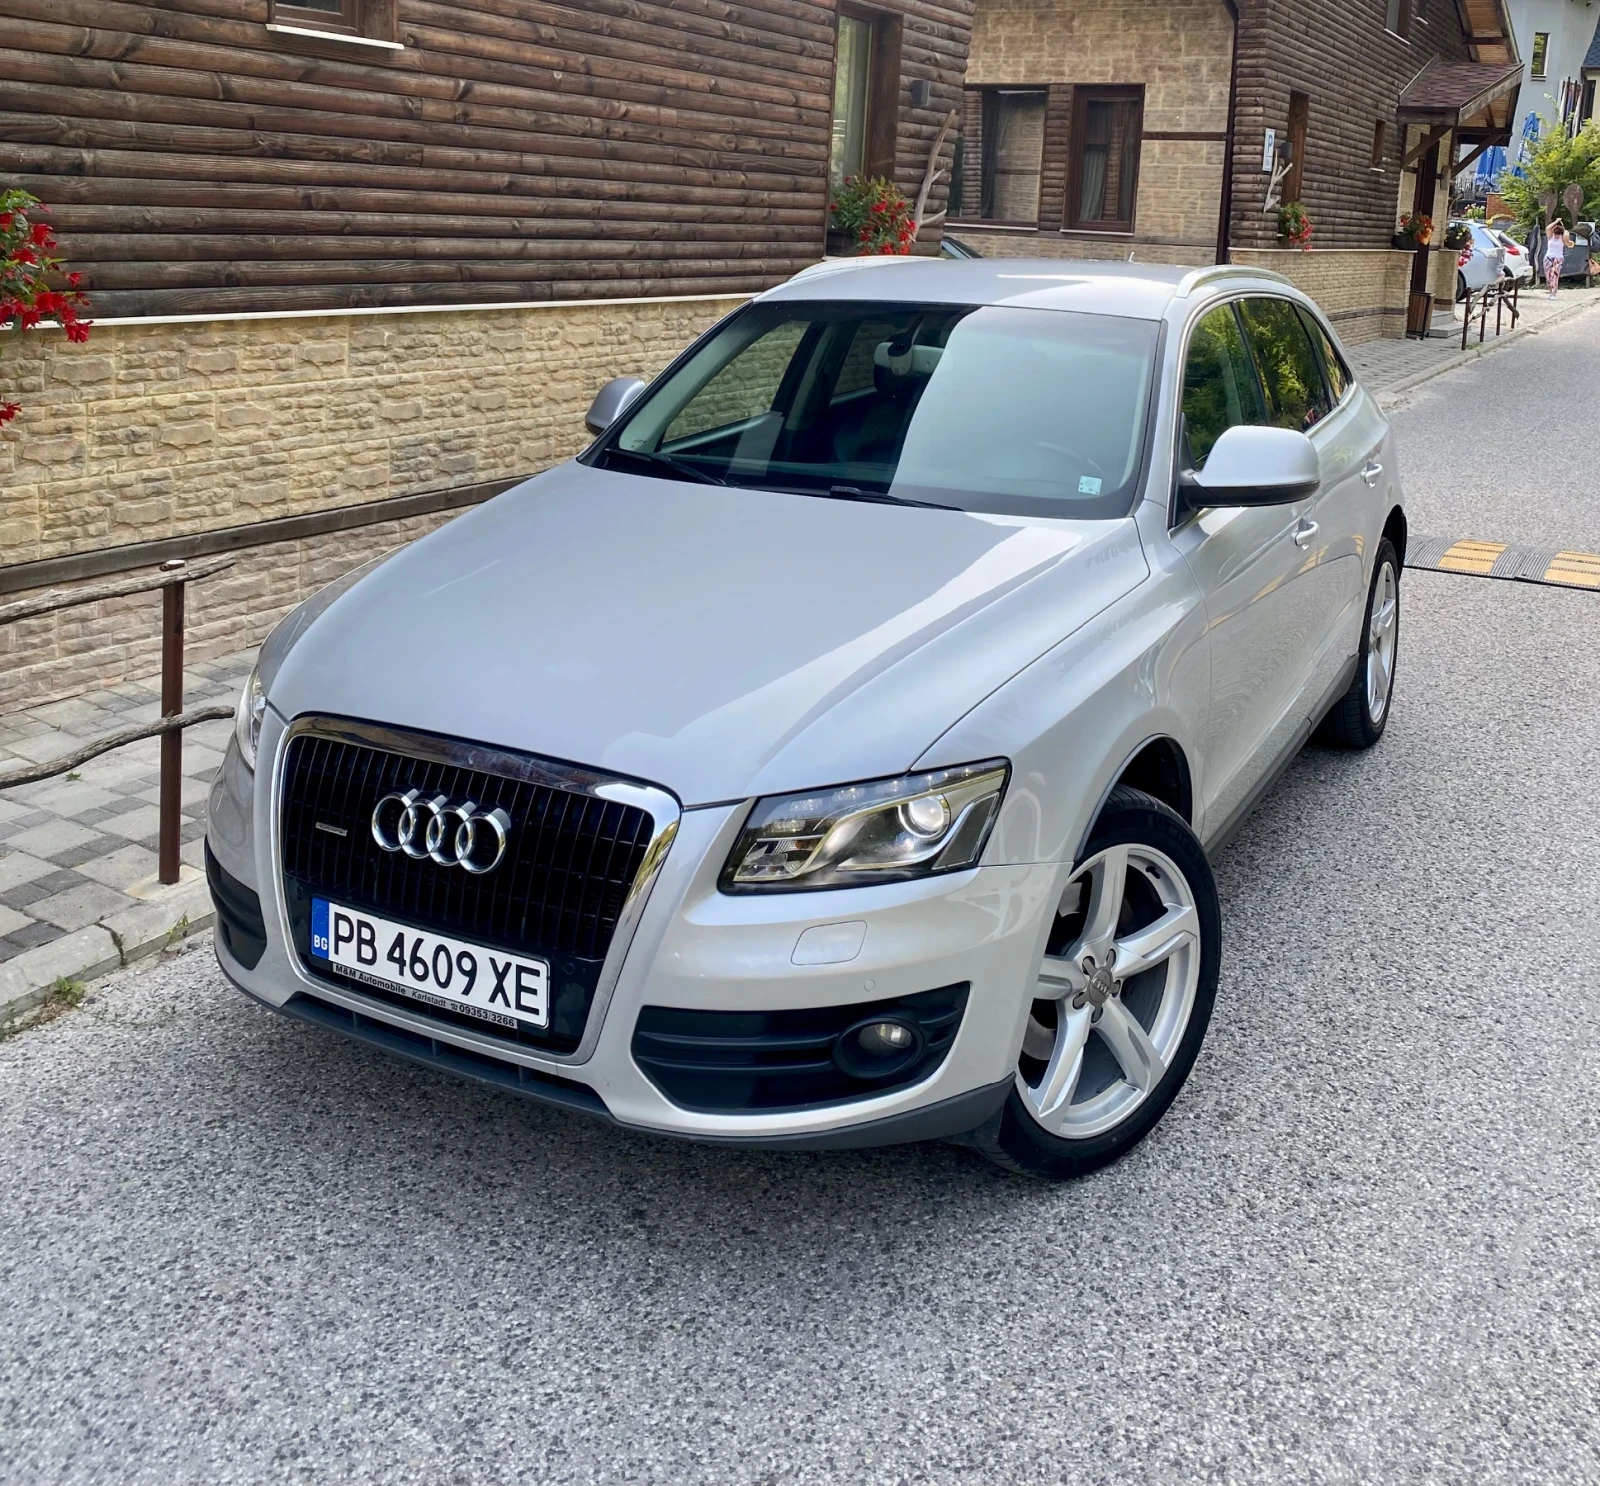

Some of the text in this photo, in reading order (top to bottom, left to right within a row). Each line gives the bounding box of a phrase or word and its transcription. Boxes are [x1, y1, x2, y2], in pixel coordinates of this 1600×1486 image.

[313, 934, 328, 951] BG
[333, 912, 541, 1016] PB 4609 XE
[335, 964, 356, 978] M&M
[358, 971, 406, 995] Automobile
[411, 990, 447, 1008] Karlstadt
